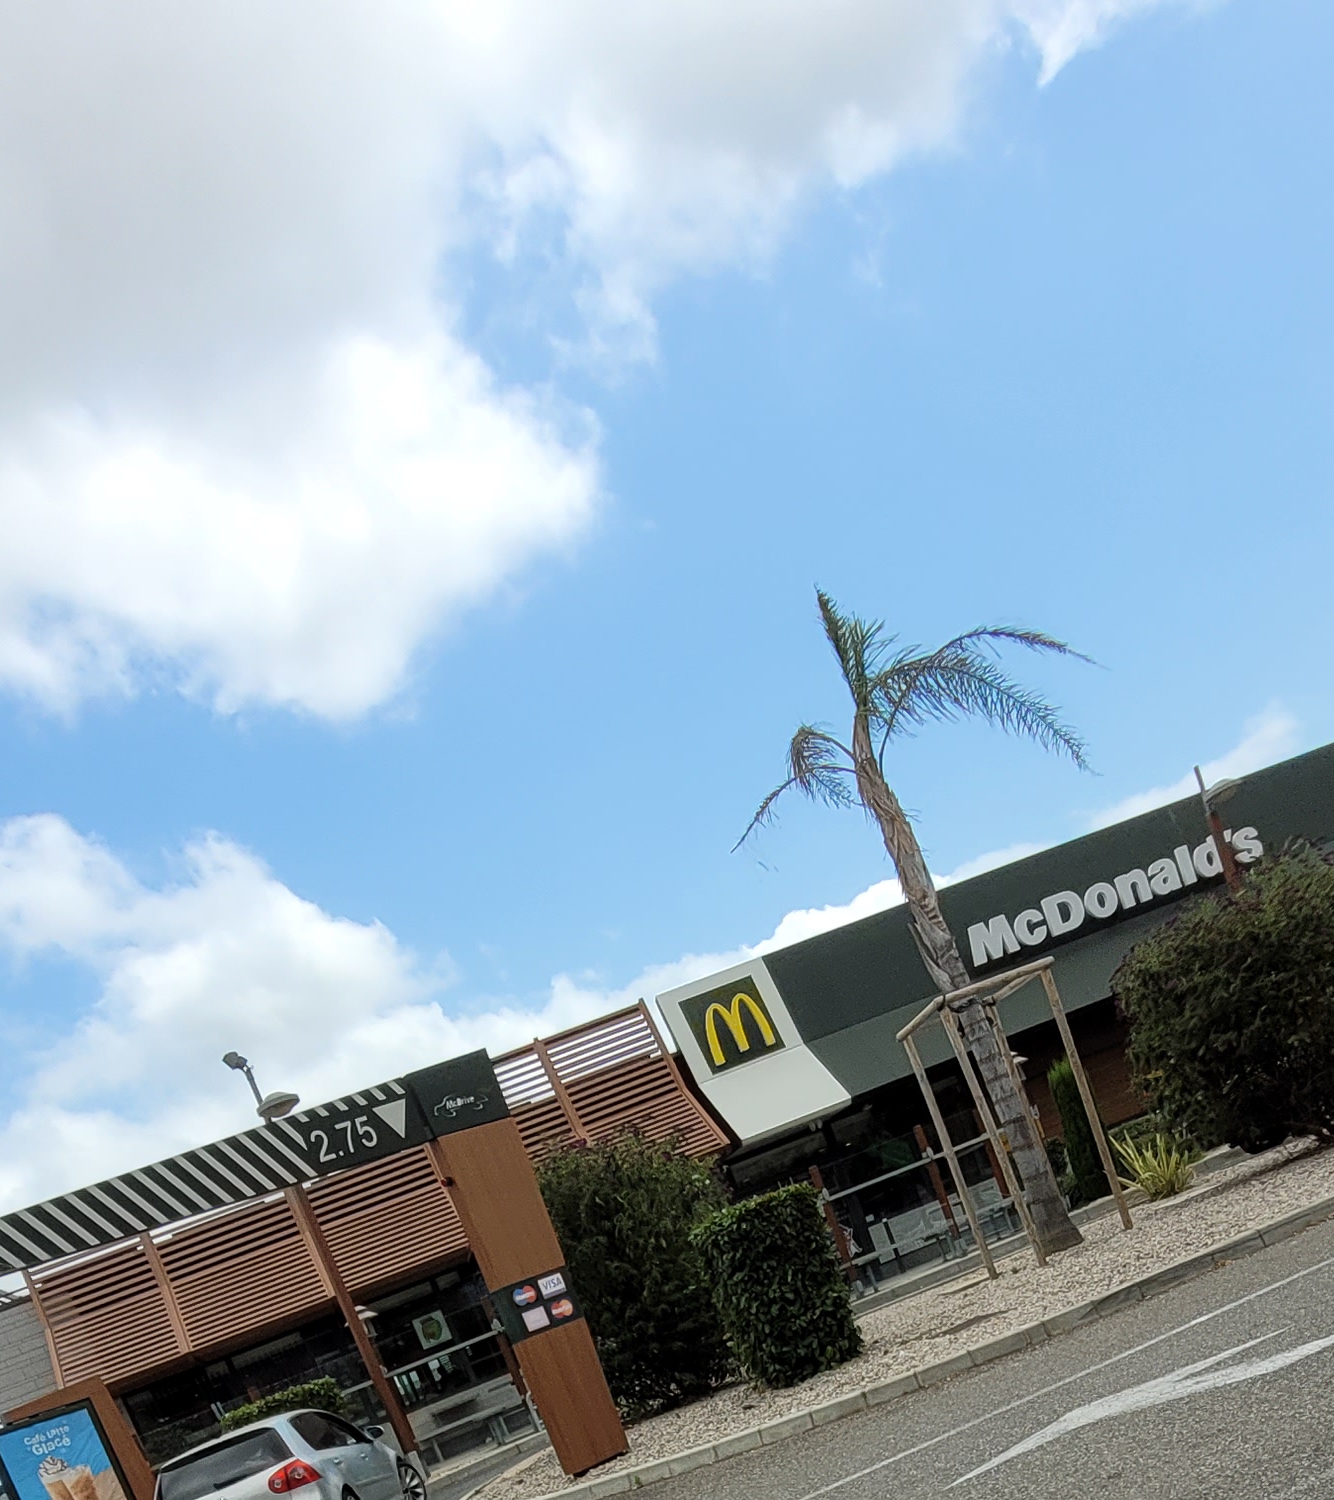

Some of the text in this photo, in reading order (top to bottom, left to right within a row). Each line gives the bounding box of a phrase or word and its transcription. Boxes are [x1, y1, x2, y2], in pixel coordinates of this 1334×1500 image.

[967, 826, 1264, 967] McDonald's
[310, 1115, 378, 1163] 2.75
[542, 1277, 562, 1290] VISA
[32, 1434, 71, 1456] Glacé
